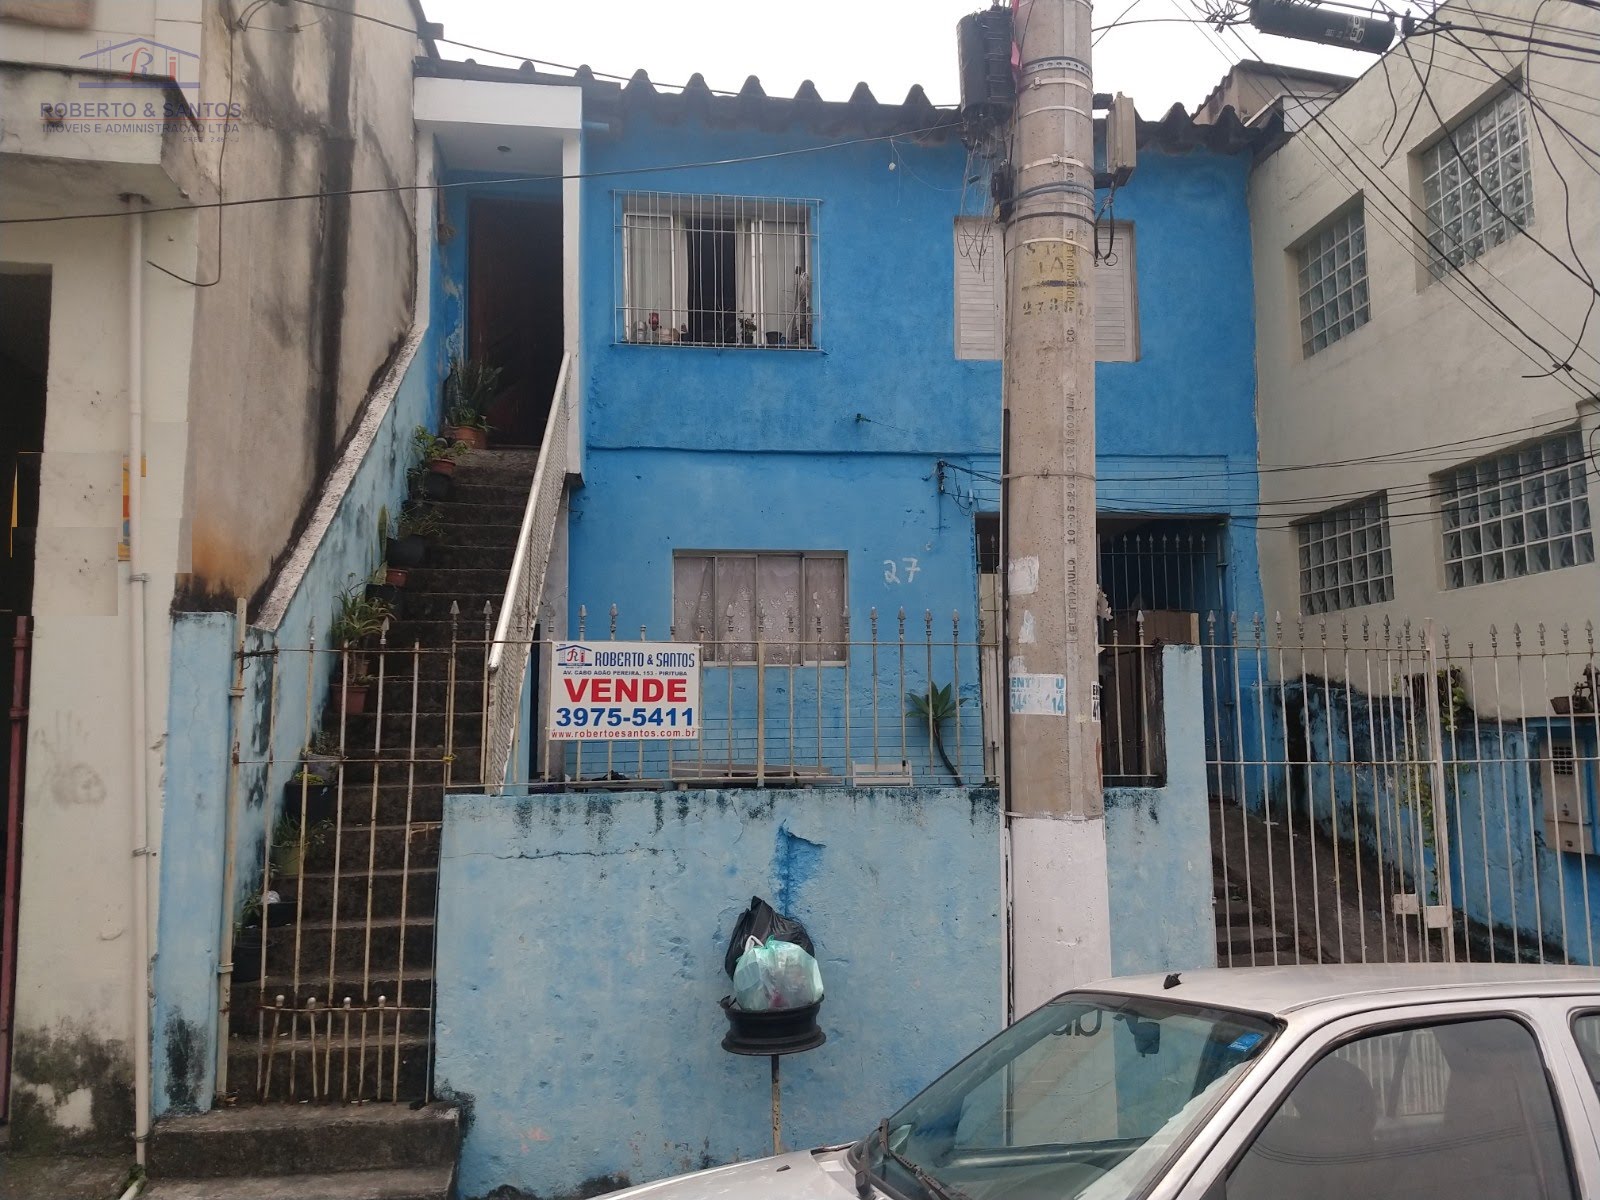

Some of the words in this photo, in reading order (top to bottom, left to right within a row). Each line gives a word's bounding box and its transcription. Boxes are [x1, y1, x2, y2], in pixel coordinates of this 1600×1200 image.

[883, 557, 921, 585] 27
[595, 651, 644, 667] ROBERTO
[647, 654, 653, 666] &
[656, 652, 695, 668] SANTOS
[563, 678, 687, 703] VENDE
[555, 707, 693, 727] 3975-5411
[551, 728, 696, 738] www.robertoesantos.com.br
